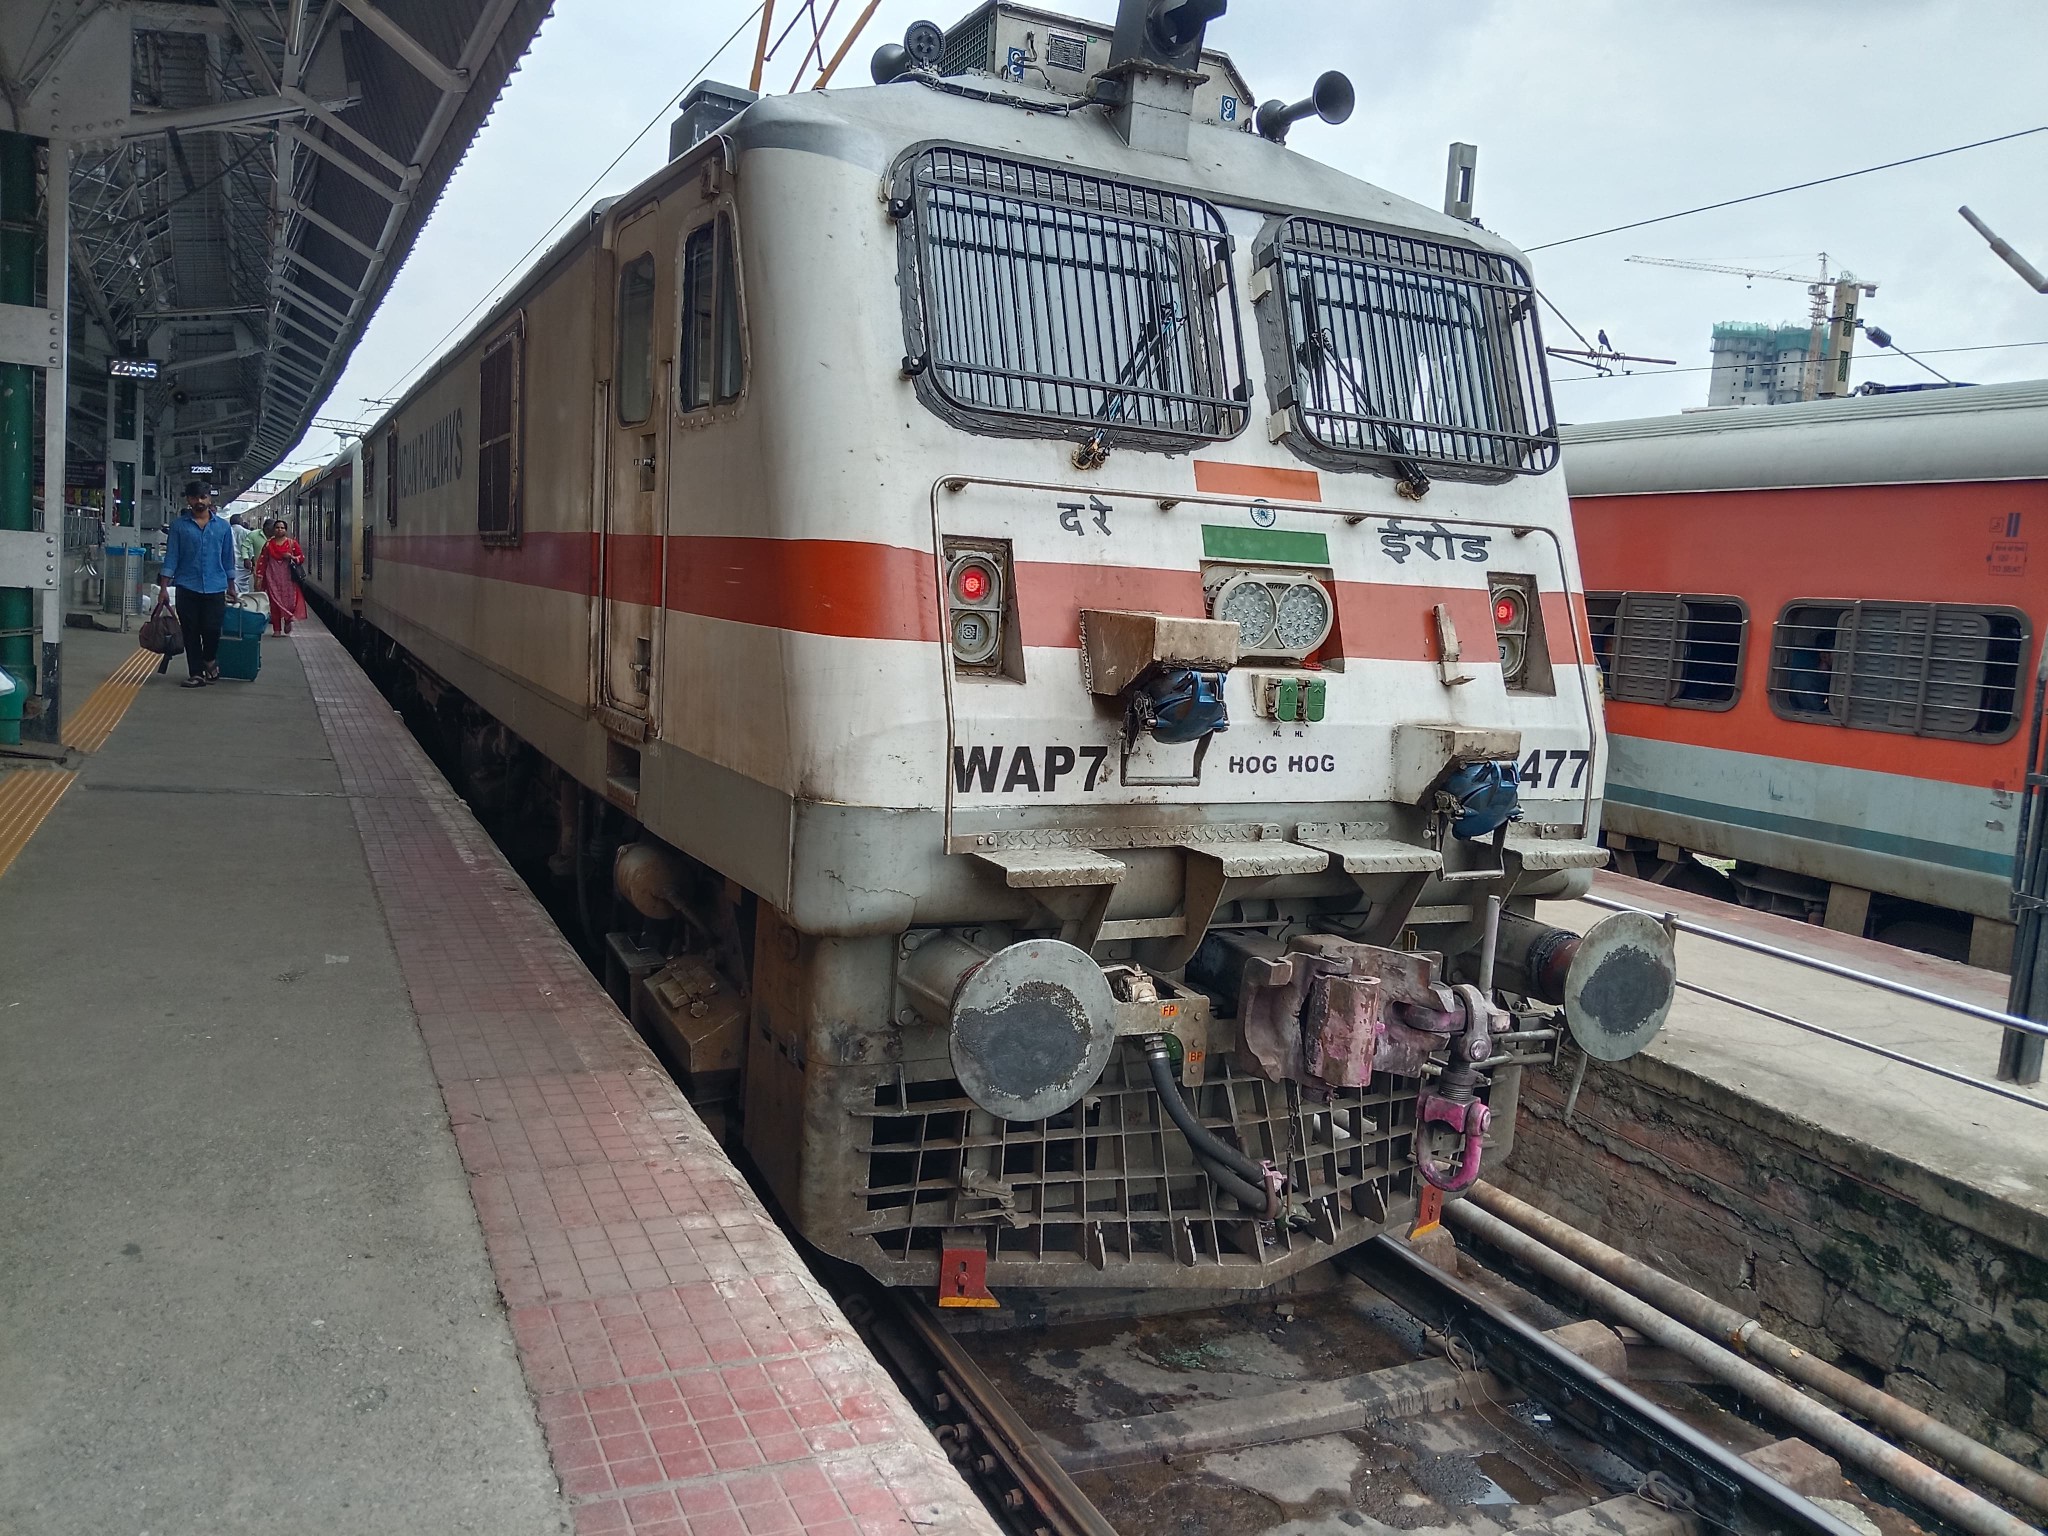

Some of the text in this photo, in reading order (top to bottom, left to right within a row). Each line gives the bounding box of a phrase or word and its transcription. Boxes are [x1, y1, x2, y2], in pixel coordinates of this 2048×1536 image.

[419, 407, 463, 494] RAILWAYS
[1377, 519, 1492, 564] ईरोड
[1294, 730, 1304, 738] HL
[954, 746, 1108, 793] WAP7
[1229, 755, 1335, 774] HOG HOG
[1163, 1005, 1175, 1016] FP
[1190, 1052, 1203, 1062] BP
